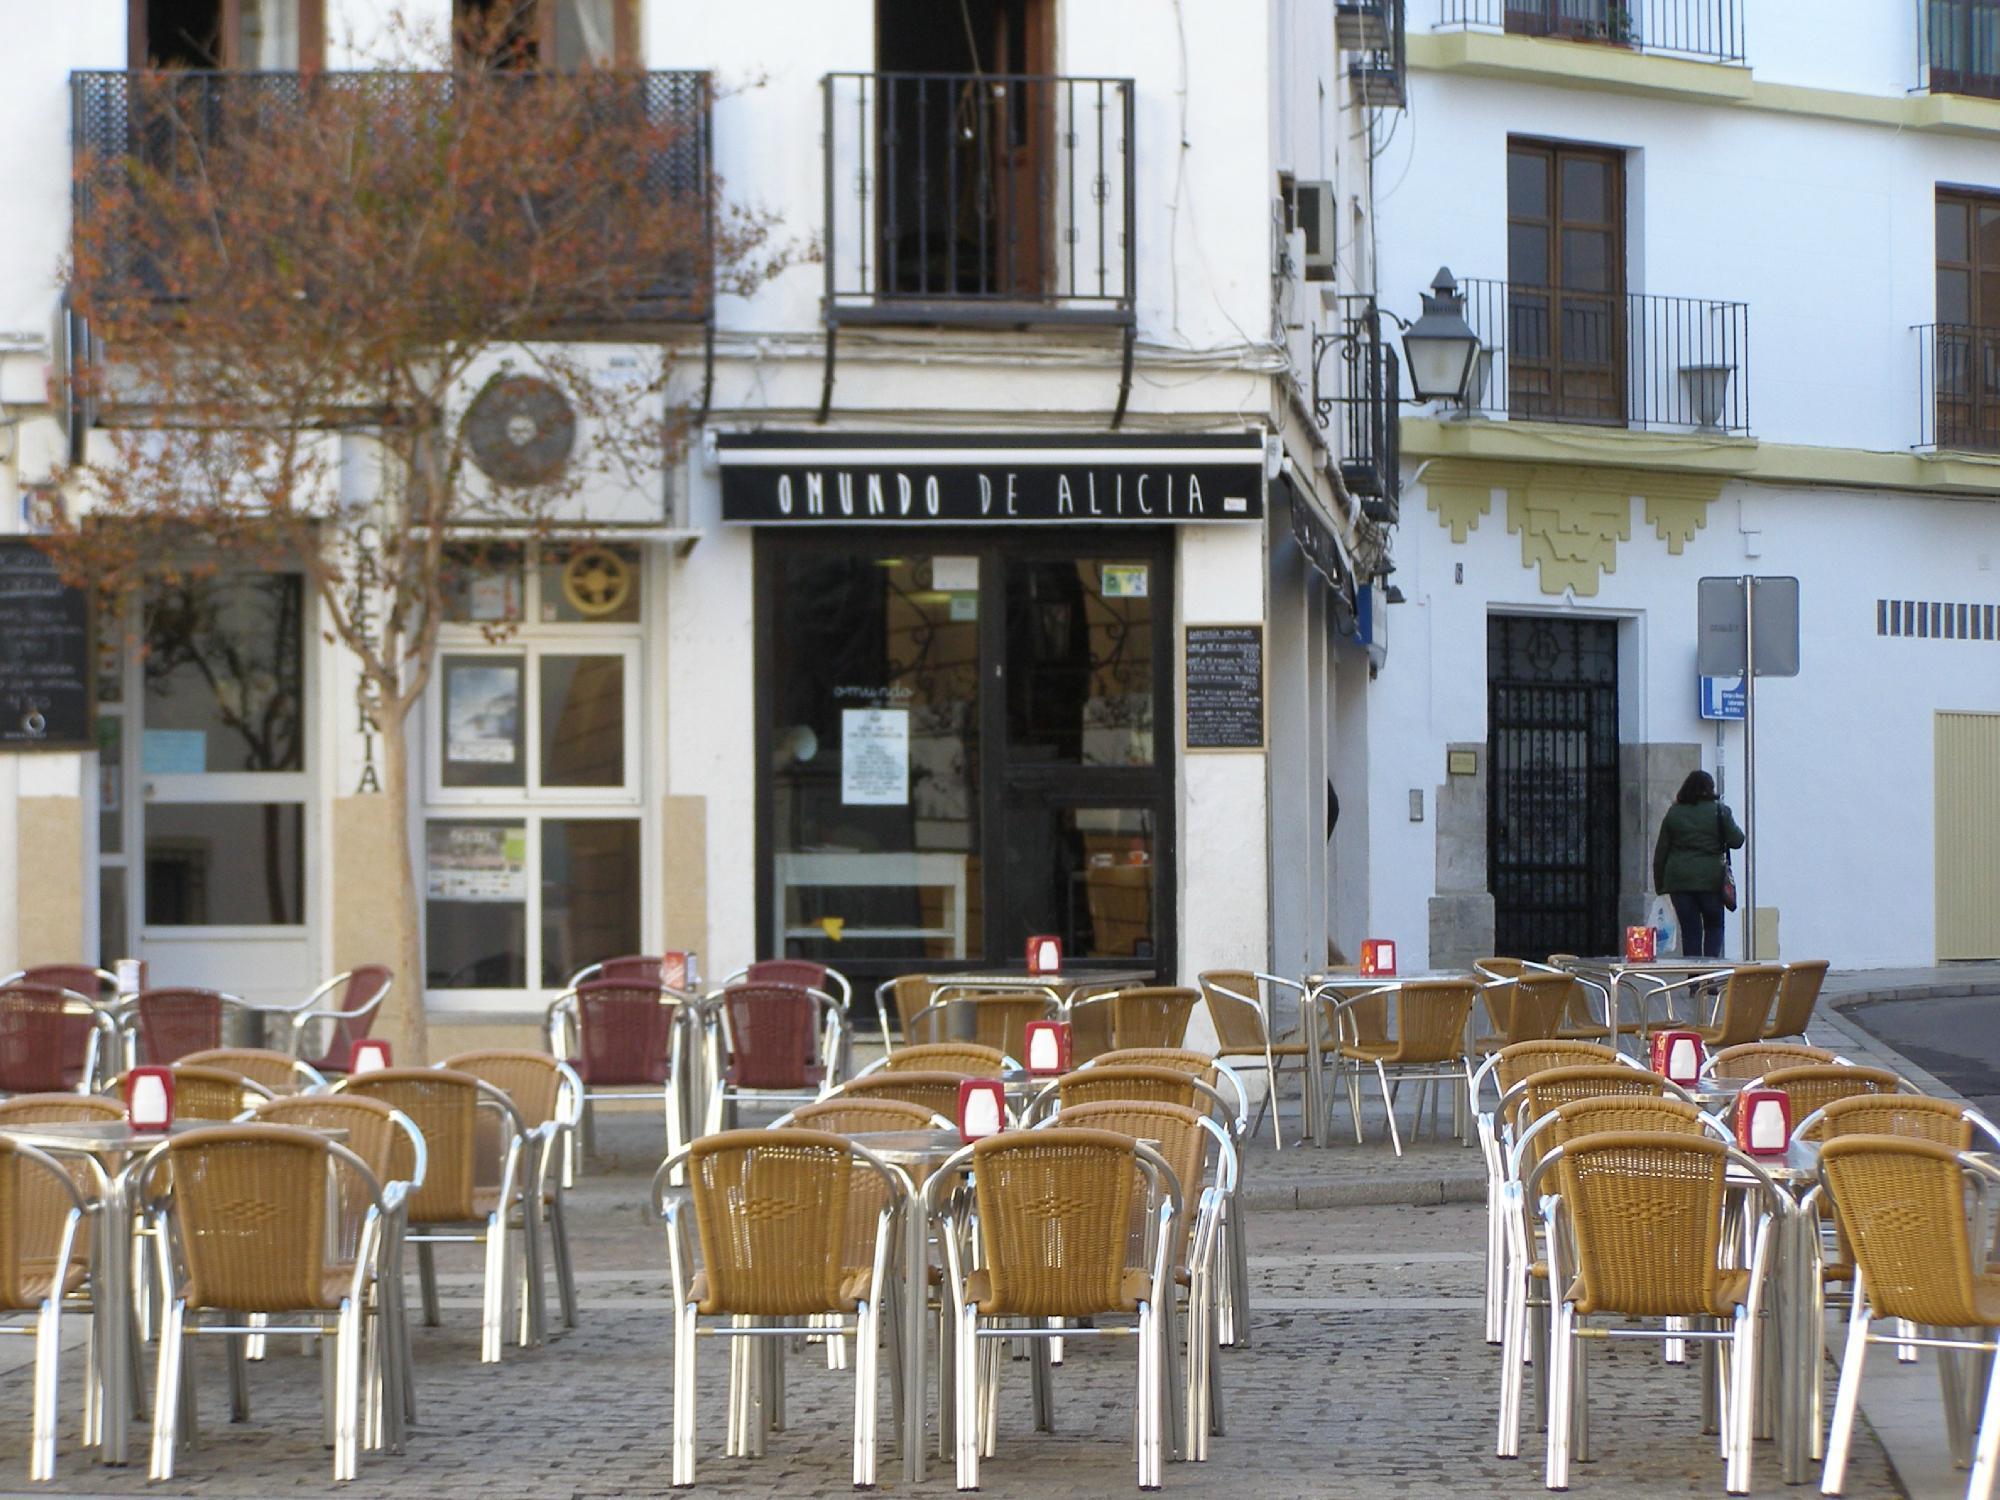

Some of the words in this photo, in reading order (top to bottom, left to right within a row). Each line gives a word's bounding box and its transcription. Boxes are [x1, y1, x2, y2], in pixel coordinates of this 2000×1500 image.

[778, 472, 940, 516] OMUNDO
[978, 473, 1018, 515] DE
[1058, 472, 1204, 515] ALICIA
